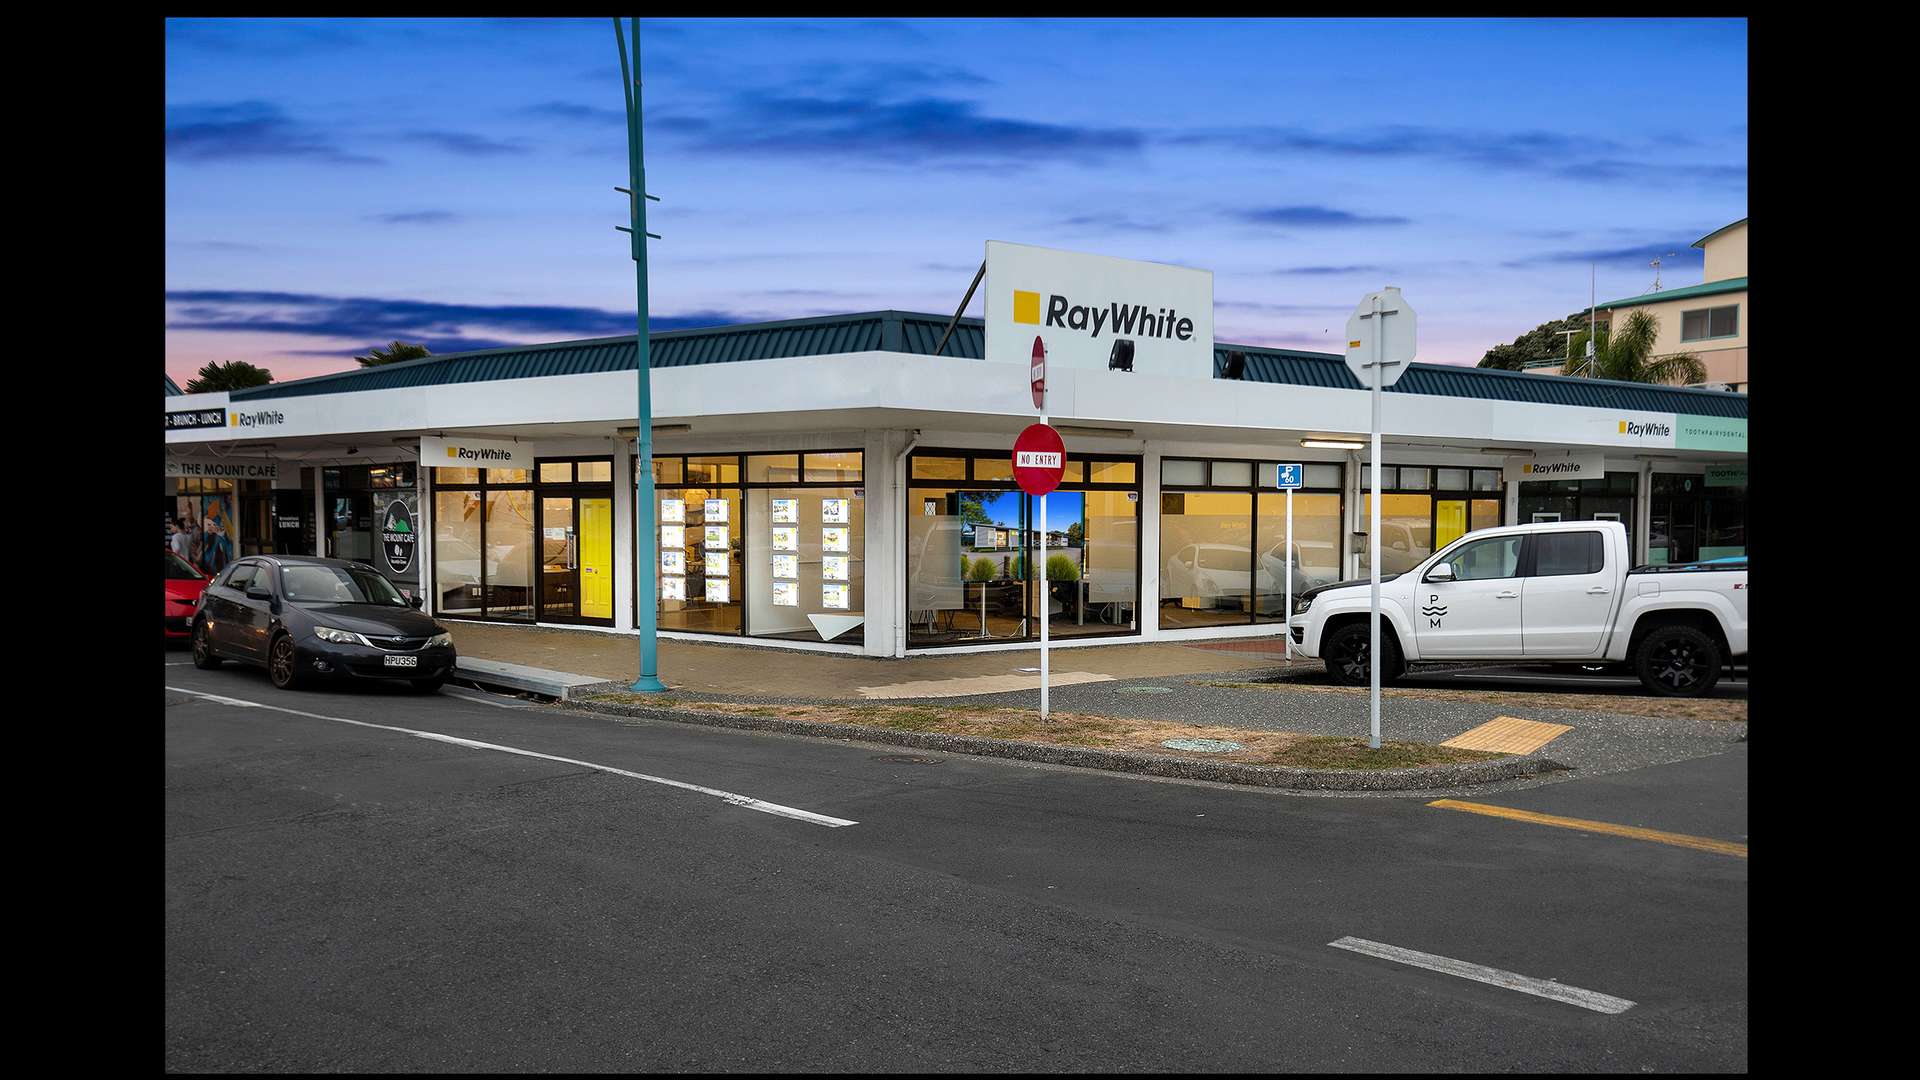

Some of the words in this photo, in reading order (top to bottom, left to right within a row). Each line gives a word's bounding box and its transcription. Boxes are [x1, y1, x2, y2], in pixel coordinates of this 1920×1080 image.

[172, 413, 198, 426] BRUNCH
[200, 412, 222, 425] LUNCH
[1021, 454, 1030, 465] NO
[1035, 454, 1057, 466] ENTRY
[181, 463, 201, 475] THE
[203, 463, 246, 476] MOUNT
[1285, 466, 1294, 474] P
[1285, 475, 1294, 484] 60
[1430, 595, 1439, 604] P
[1430, 618, 1440, 628] M
[385, 656, 417, 666] HPU356
